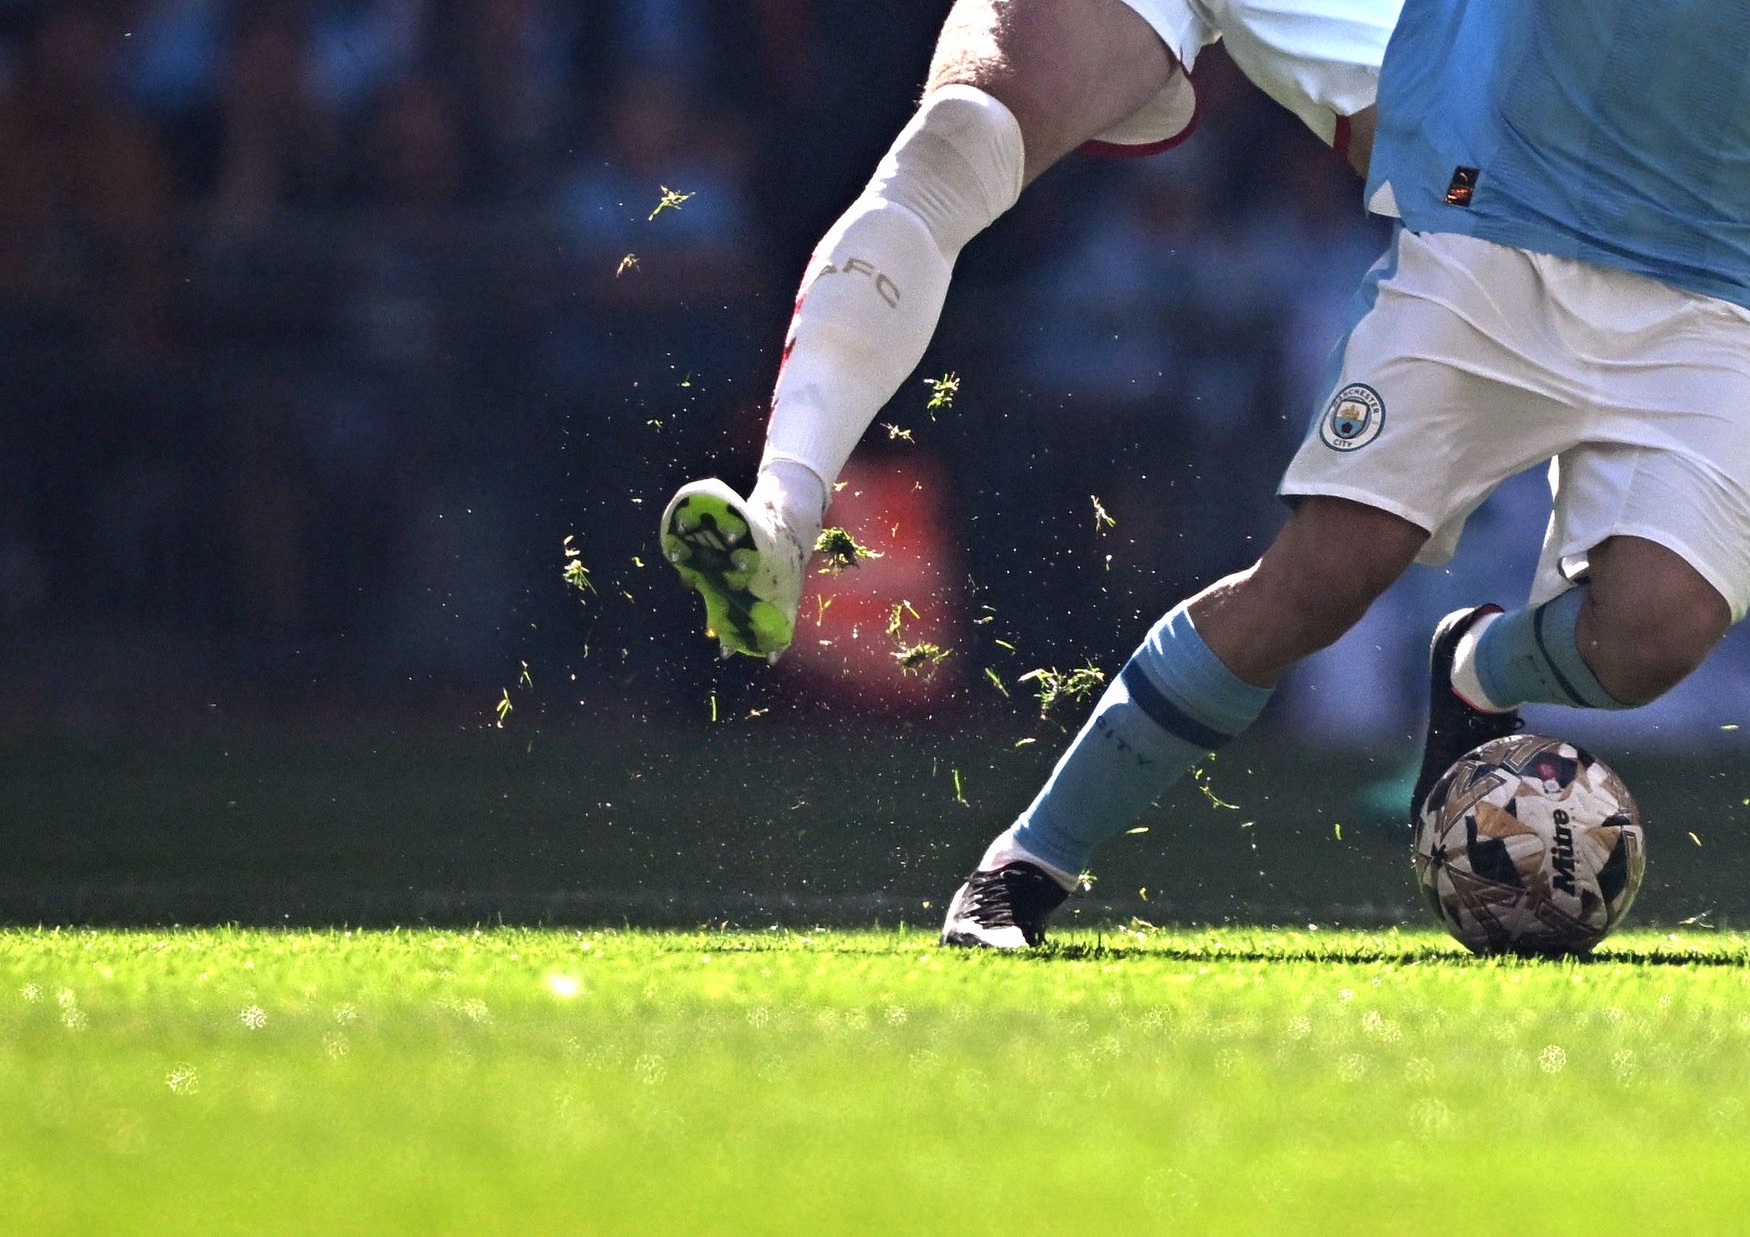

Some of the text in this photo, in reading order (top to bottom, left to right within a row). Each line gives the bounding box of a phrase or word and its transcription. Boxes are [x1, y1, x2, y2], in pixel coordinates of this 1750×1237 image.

[1333, 388, 1380, 414] MANCHESTER
[1332, 438, 1353, 448] CITY
[1550, 808, 1576, 898] Mitre
